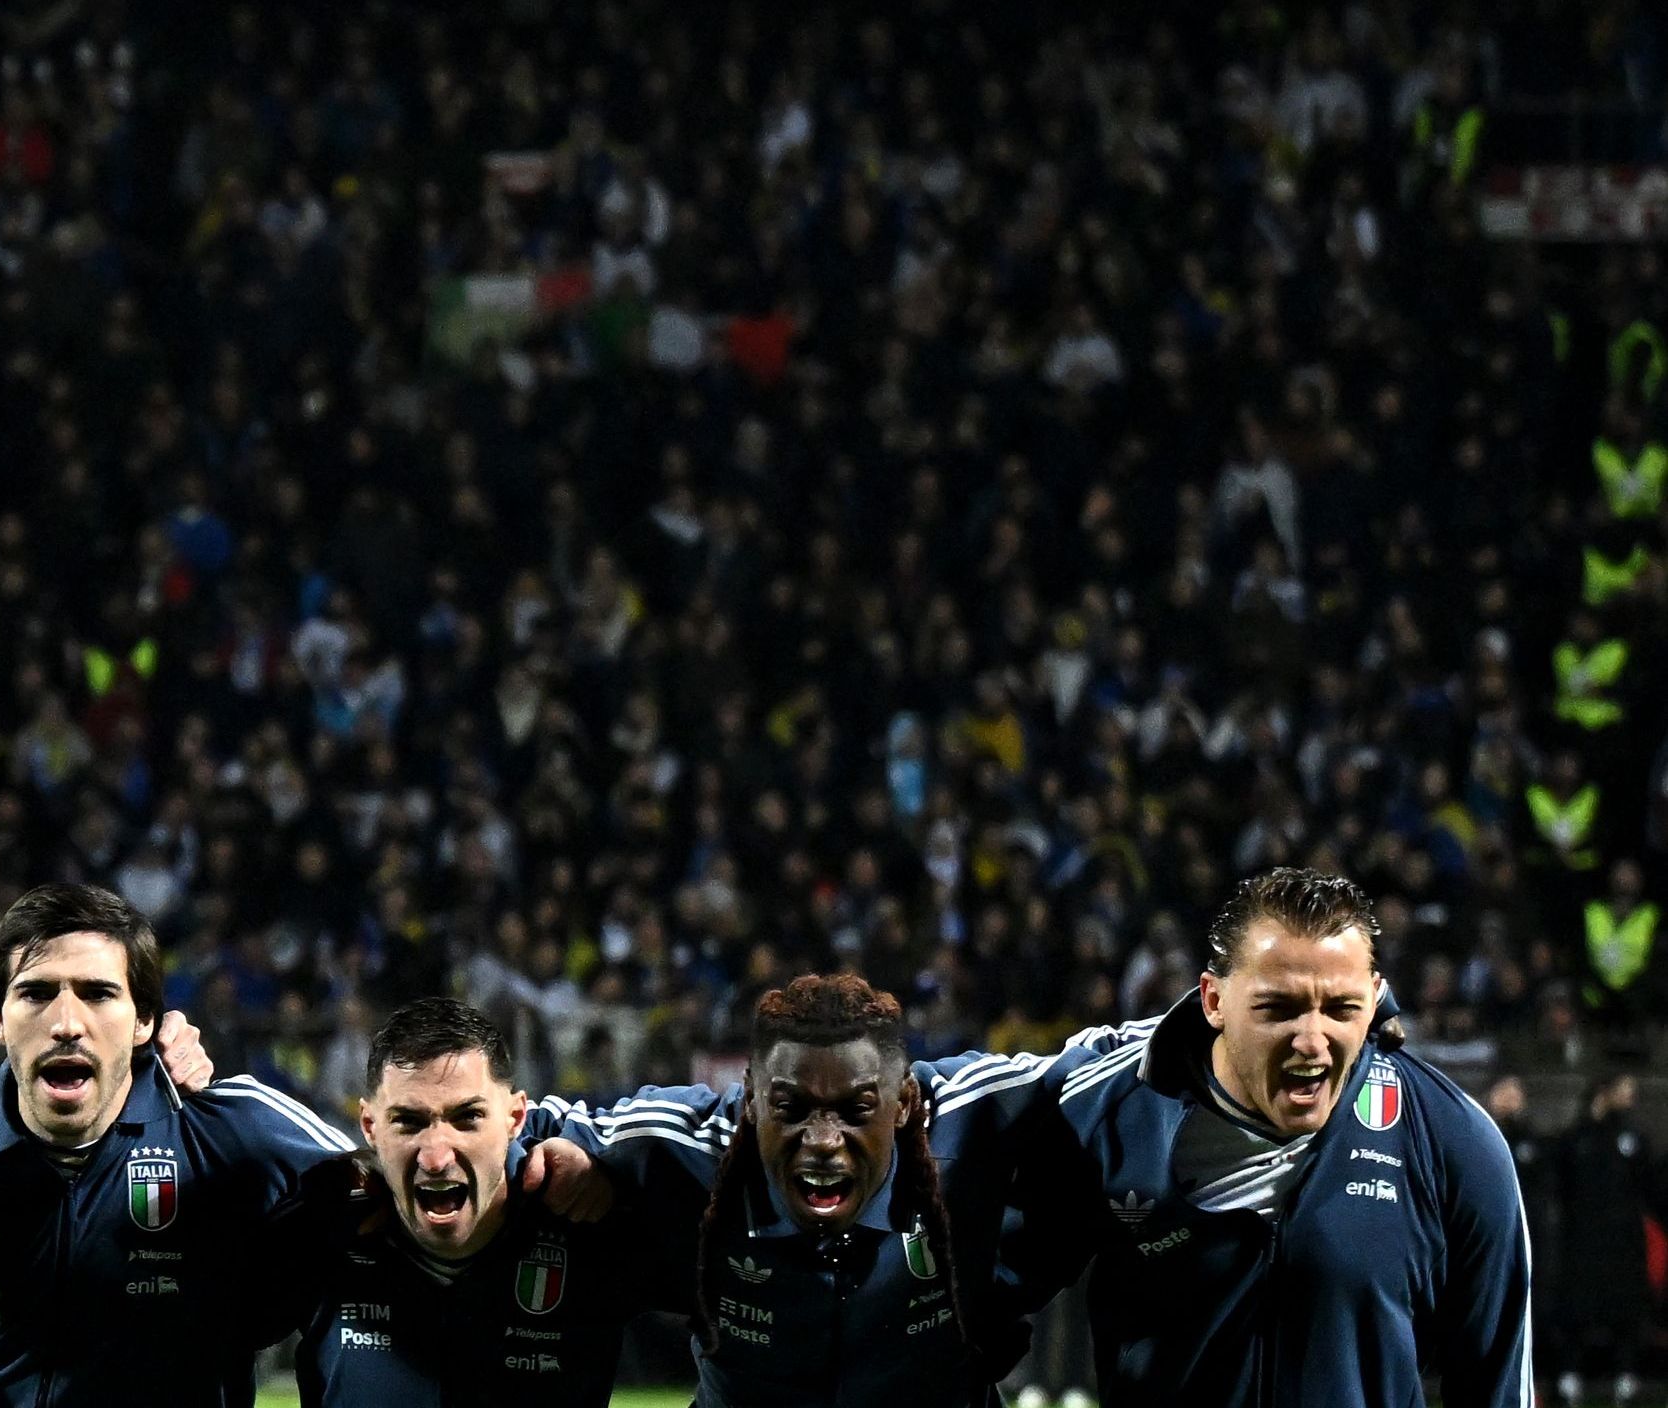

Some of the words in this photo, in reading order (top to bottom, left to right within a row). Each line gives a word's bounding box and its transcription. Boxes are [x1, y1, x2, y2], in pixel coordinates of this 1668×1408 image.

[1367, 1067, 1397, 1083] ALIA
[1360, 1148, 1403, 1168] Telepass
[131, 1164, 172, 1179] ITALIA
[1346, 1178, 1375, 1197] eni
[1138, 1225, 1191, 1257] Poste
[125, 1276, 155, 1294] eni
[359, 1304, 391, 1321] TIM
[740, 1303, 774, 1325] TIM
[719, 1317, 771, 1344] Poste
[906, 1313, 936, 1335] eni
[340, 1327, 392, 1346] Poste
[504, 1353, 536, 1371] eni
